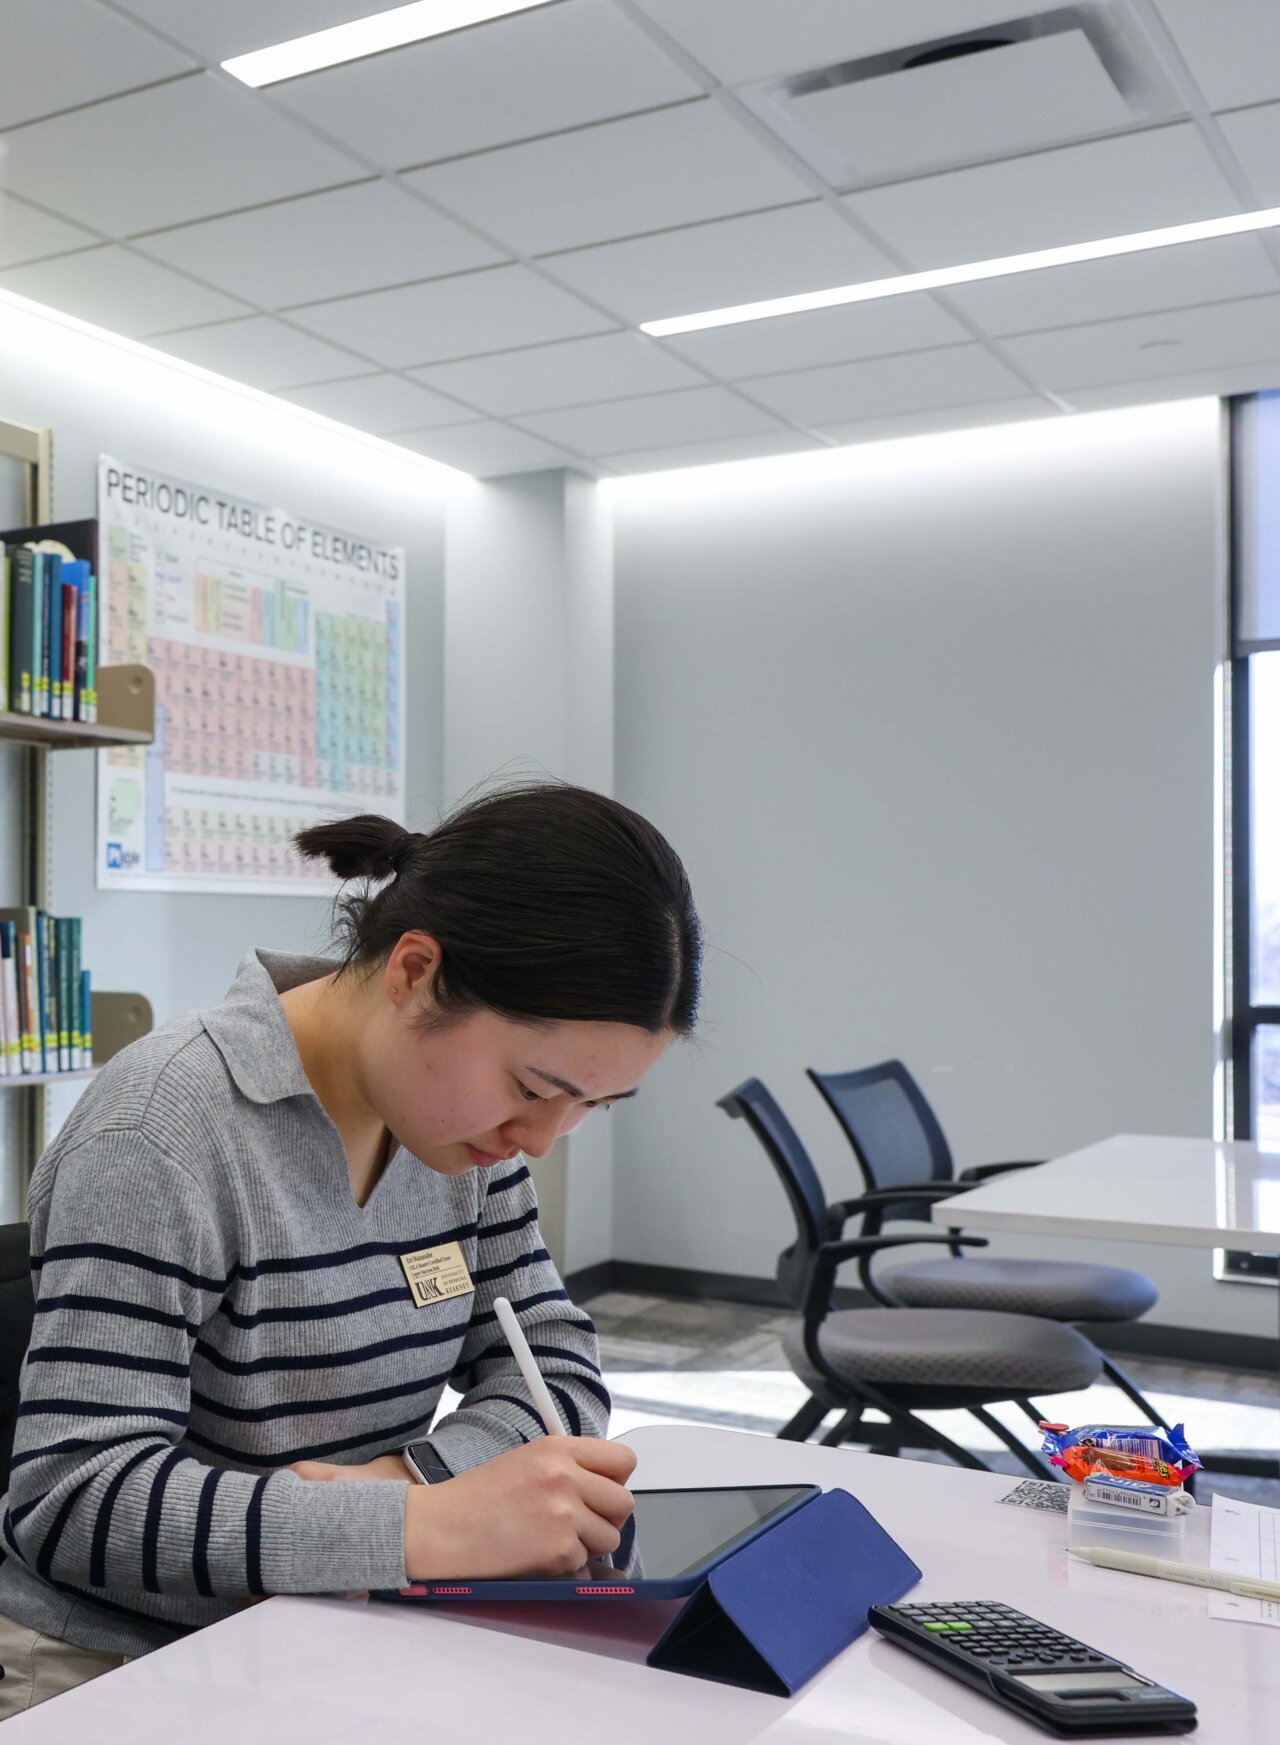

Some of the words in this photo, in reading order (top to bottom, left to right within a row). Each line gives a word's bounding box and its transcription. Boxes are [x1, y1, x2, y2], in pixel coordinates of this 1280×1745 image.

[106, 468, 210, 526] PERIODIC
[216, 500, 276, 545] TABLE
[281, 521, 307, 552] OF
[311, 529, 400, 581] ELEMENTS
[445, 1282, 470, 1294] KEARNEY
